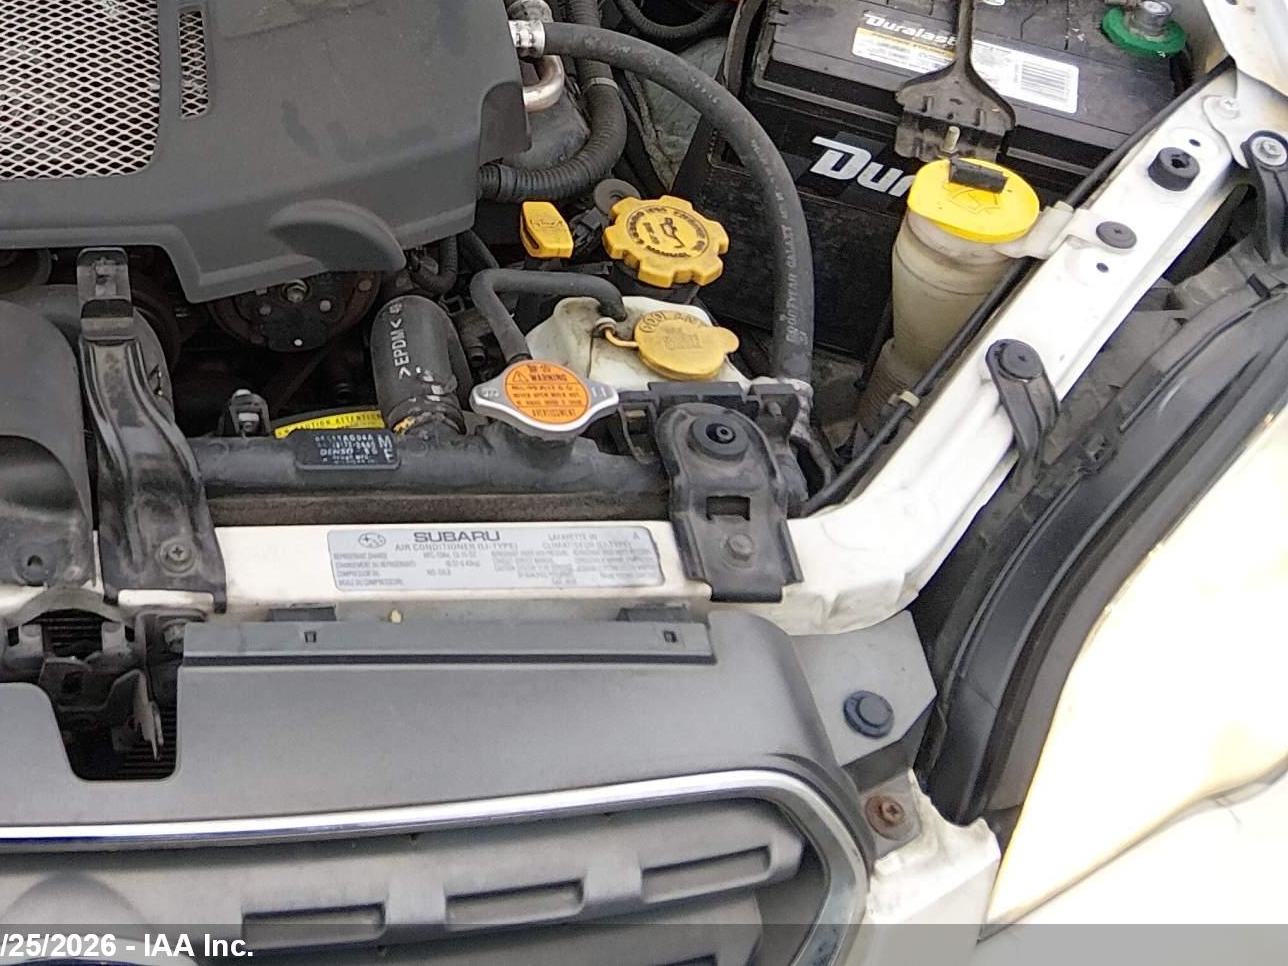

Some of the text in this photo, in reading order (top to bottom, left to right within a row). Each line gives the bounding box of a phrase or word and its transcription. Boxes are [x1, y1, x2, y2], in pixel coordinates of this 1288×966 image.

[863, 12, 957, 46] Duralast
[413, 531, 501, 543] SUBARU
[395, 543, 411, 551] AIR
[413, 543, 476, 551] CONDITIONER
